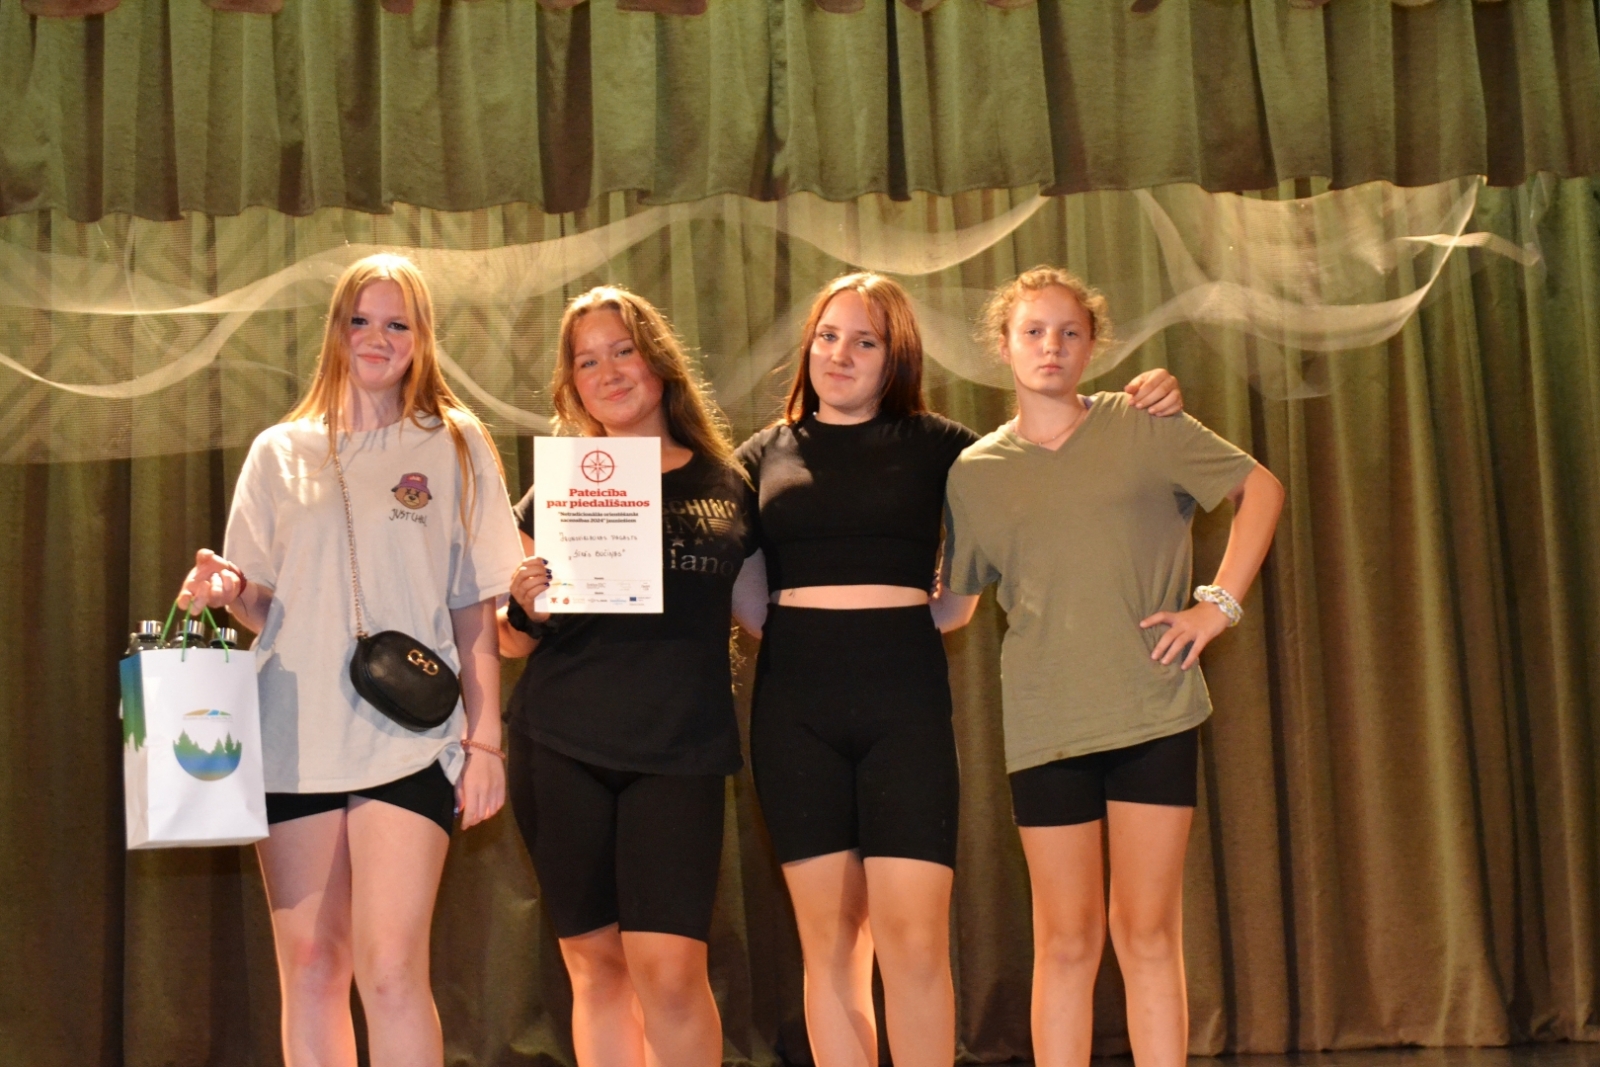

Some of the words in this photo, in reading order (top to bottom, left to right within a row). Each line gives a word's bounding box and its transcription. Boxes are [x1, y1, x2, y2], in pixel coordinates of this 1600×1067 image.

[569, 488, 627, 497] Pateicība
[546, 500, 567, 508] par
[569, 499, 650, 508] piedalīšanos
[389, 508, 411, 521] JUST
